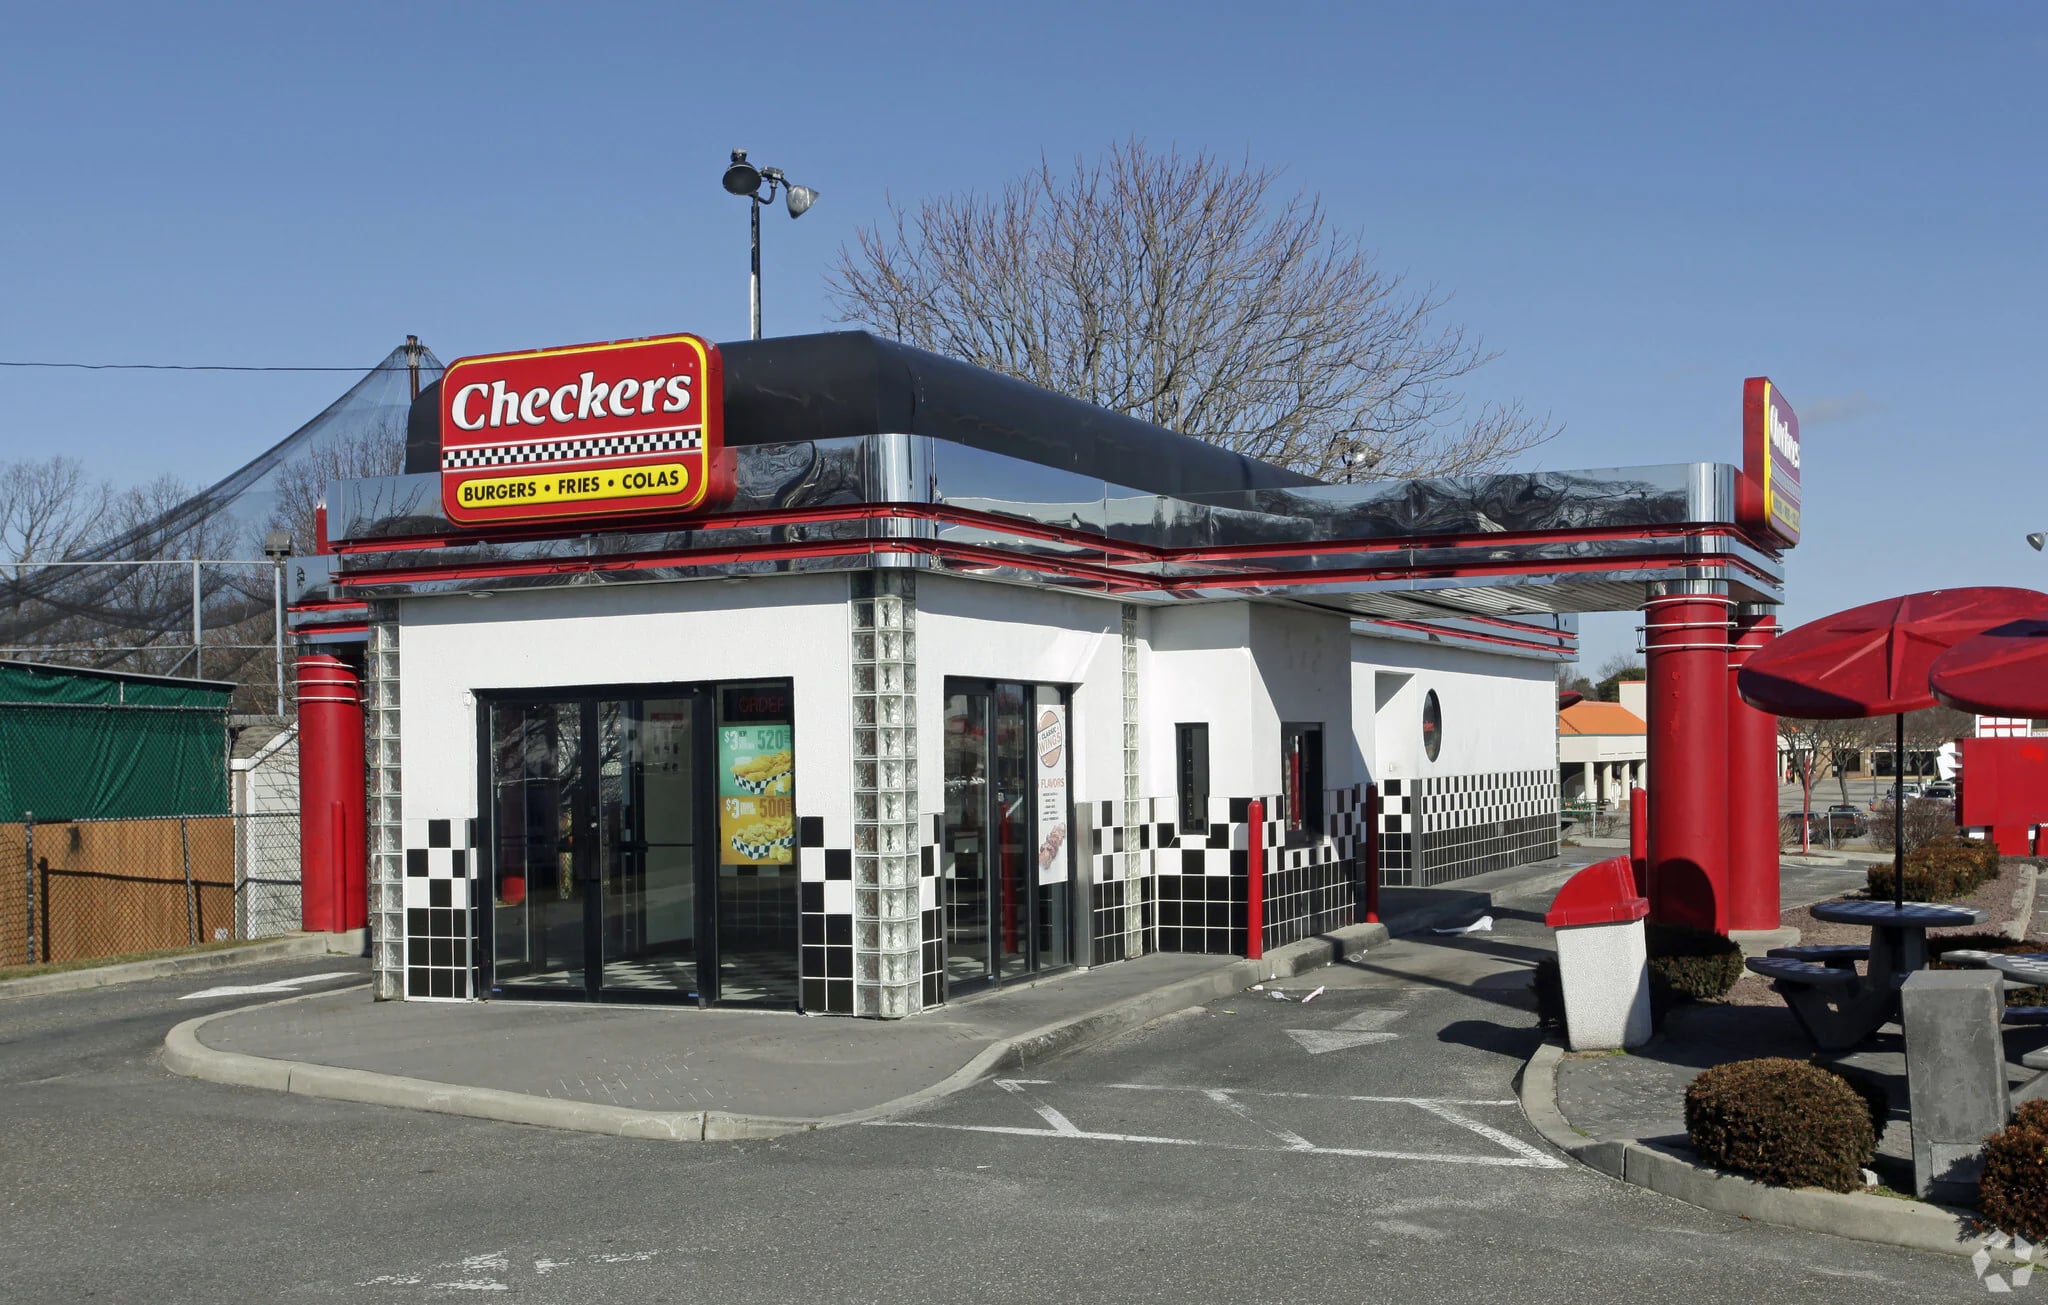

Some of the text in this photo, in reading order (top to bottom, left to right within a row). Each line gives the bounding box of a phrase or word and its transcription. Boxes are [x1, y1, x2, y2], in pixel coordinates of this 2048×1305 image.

[451, 371, 692, 431] Checkers
[464, 470, 679, 502] BURGERS FRIES COLAS
[757, 729, 784, 750] 520
[1039, 731, 1062, 754] WINGS
[1040, 777, 1065, 789] FLAVORS
[726, 798, 740, 819] $3
[759, 798, 786, 818] 500
